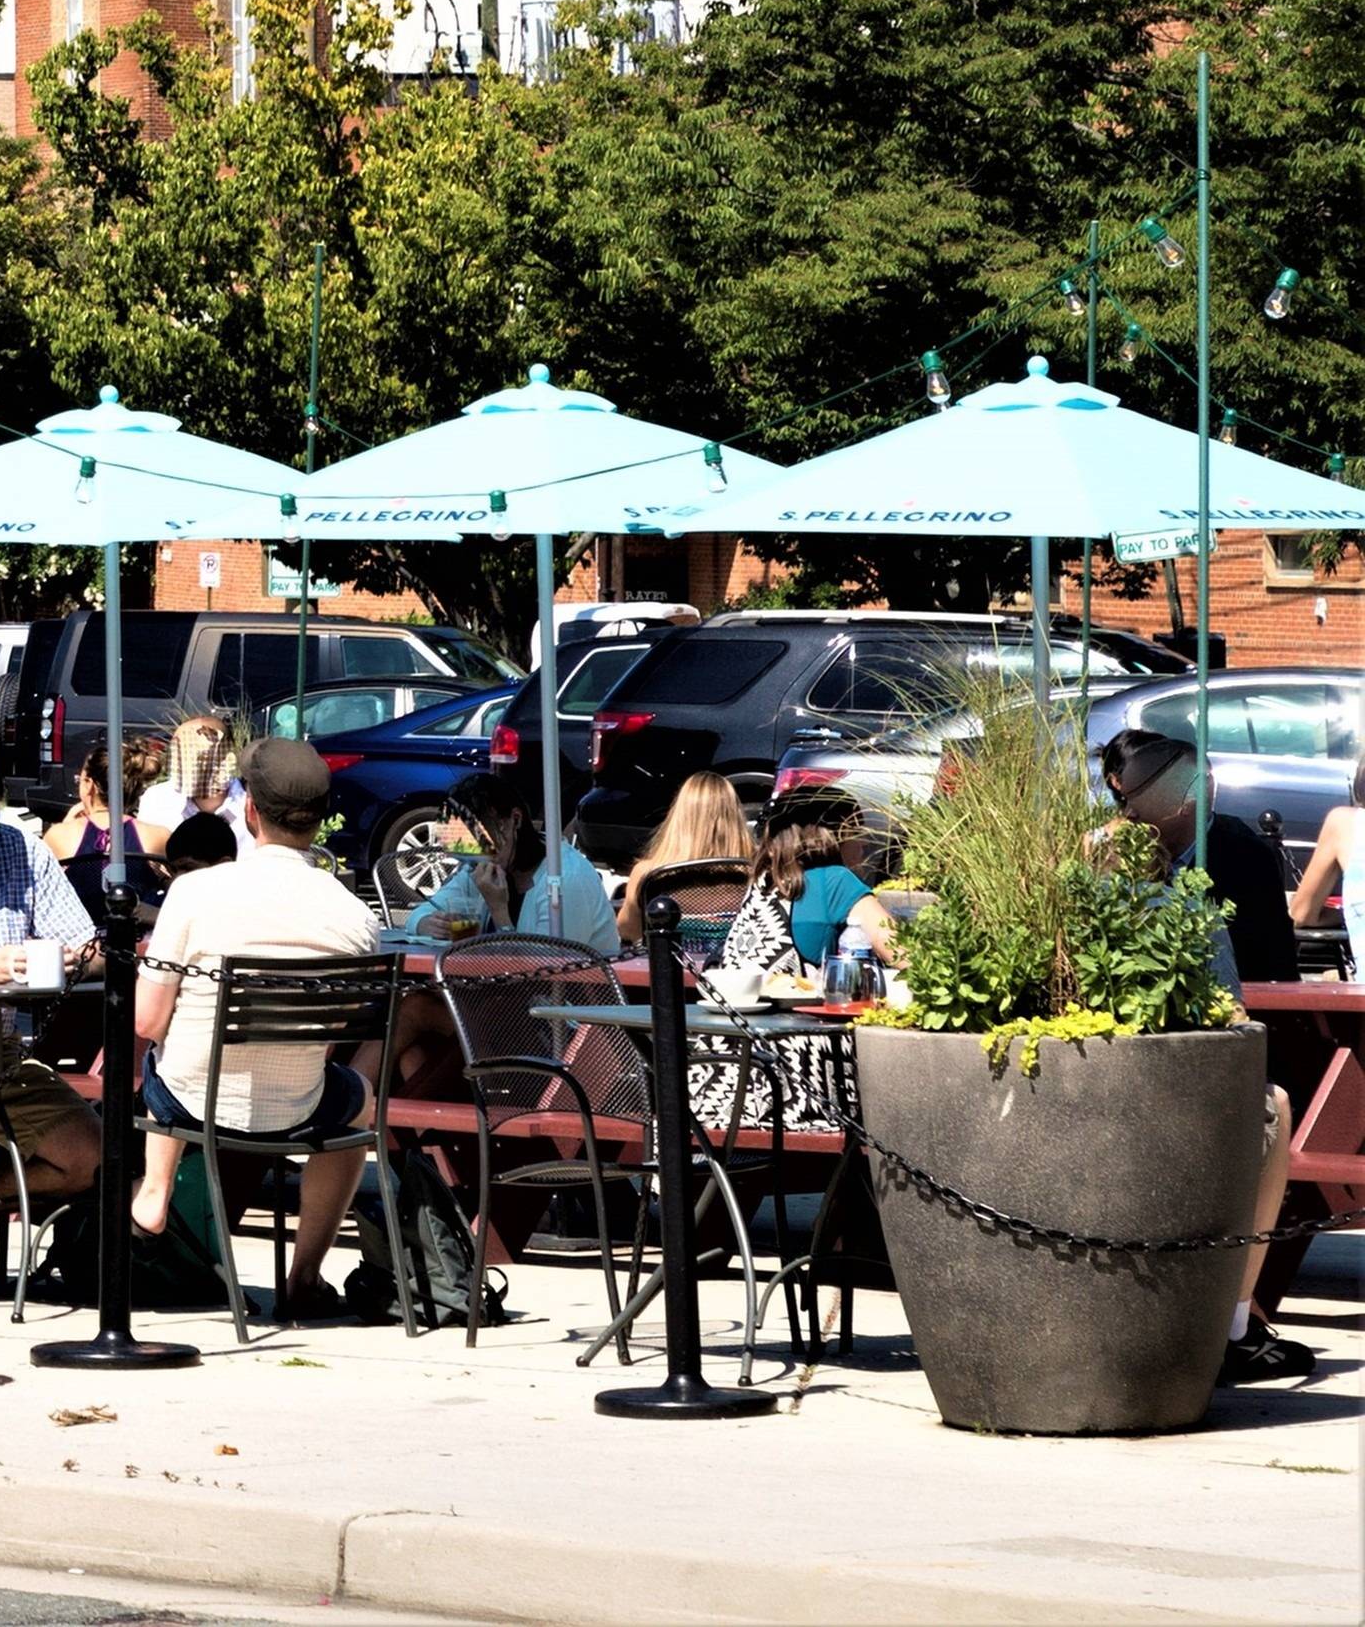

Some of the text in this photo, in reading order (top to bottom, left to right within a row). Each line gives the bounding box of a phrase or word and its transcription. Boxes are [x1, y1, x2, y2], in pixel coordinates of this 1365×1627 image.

[304, 510, 489, 522] PELLEGRINO
[1117, 533, 1211, 555] PAY TO PAR
[271, 582, 290, 591] PAY
